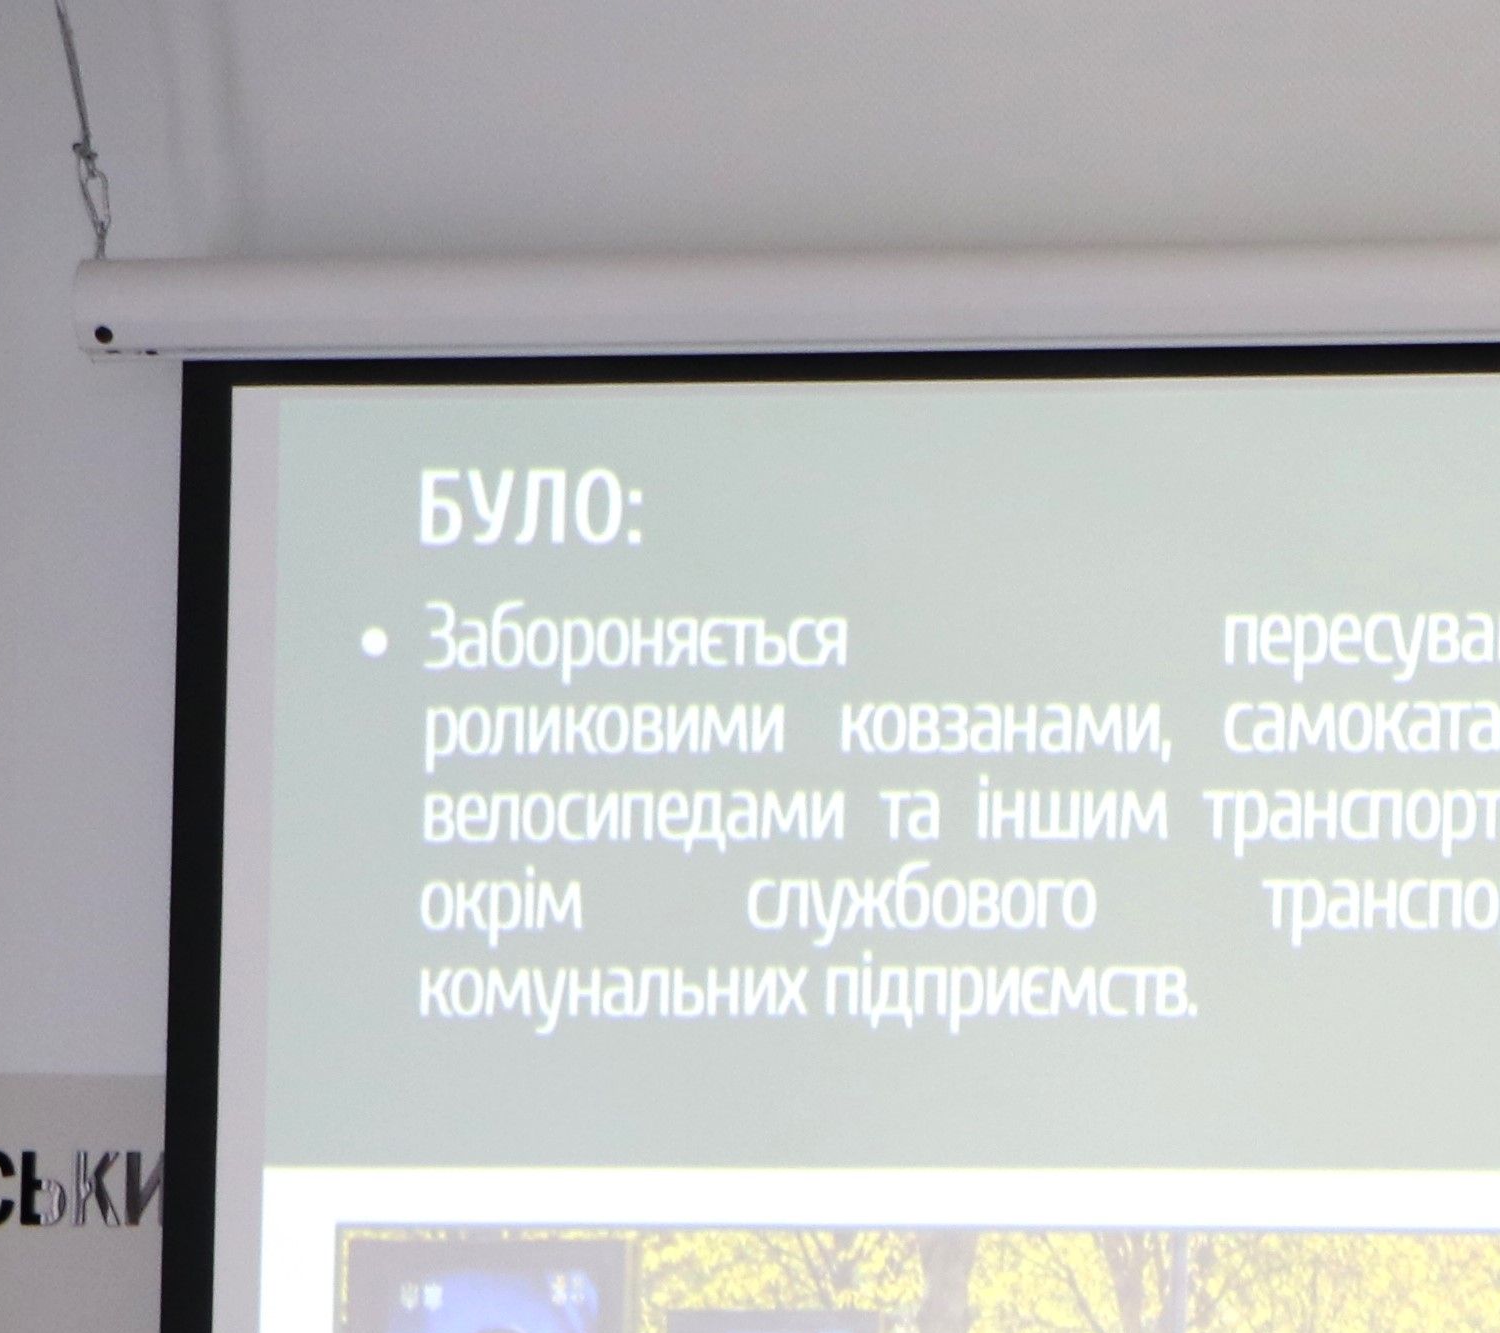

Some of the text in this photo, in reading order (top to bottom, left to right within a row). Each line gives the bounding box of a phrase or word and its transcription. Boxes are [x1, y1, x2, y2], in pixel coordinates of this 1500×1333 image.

[418, 466, 645, 547] БУЛО:
[423, 598, 851, 687] Забороняється
[423, 701, 787, 775] роликовими
[839, 701, 1174, 765] ковзанами,
[421, 788, 848, 856] велосипедами
[877, 788, 942, 842] та
[975, 773, 1171, 842] іншим
[418, 863, 585, 950] окрім
[745, 858, 1100, 949] службового
[418, 948, 1200, 1037] комунальних підприємств.
